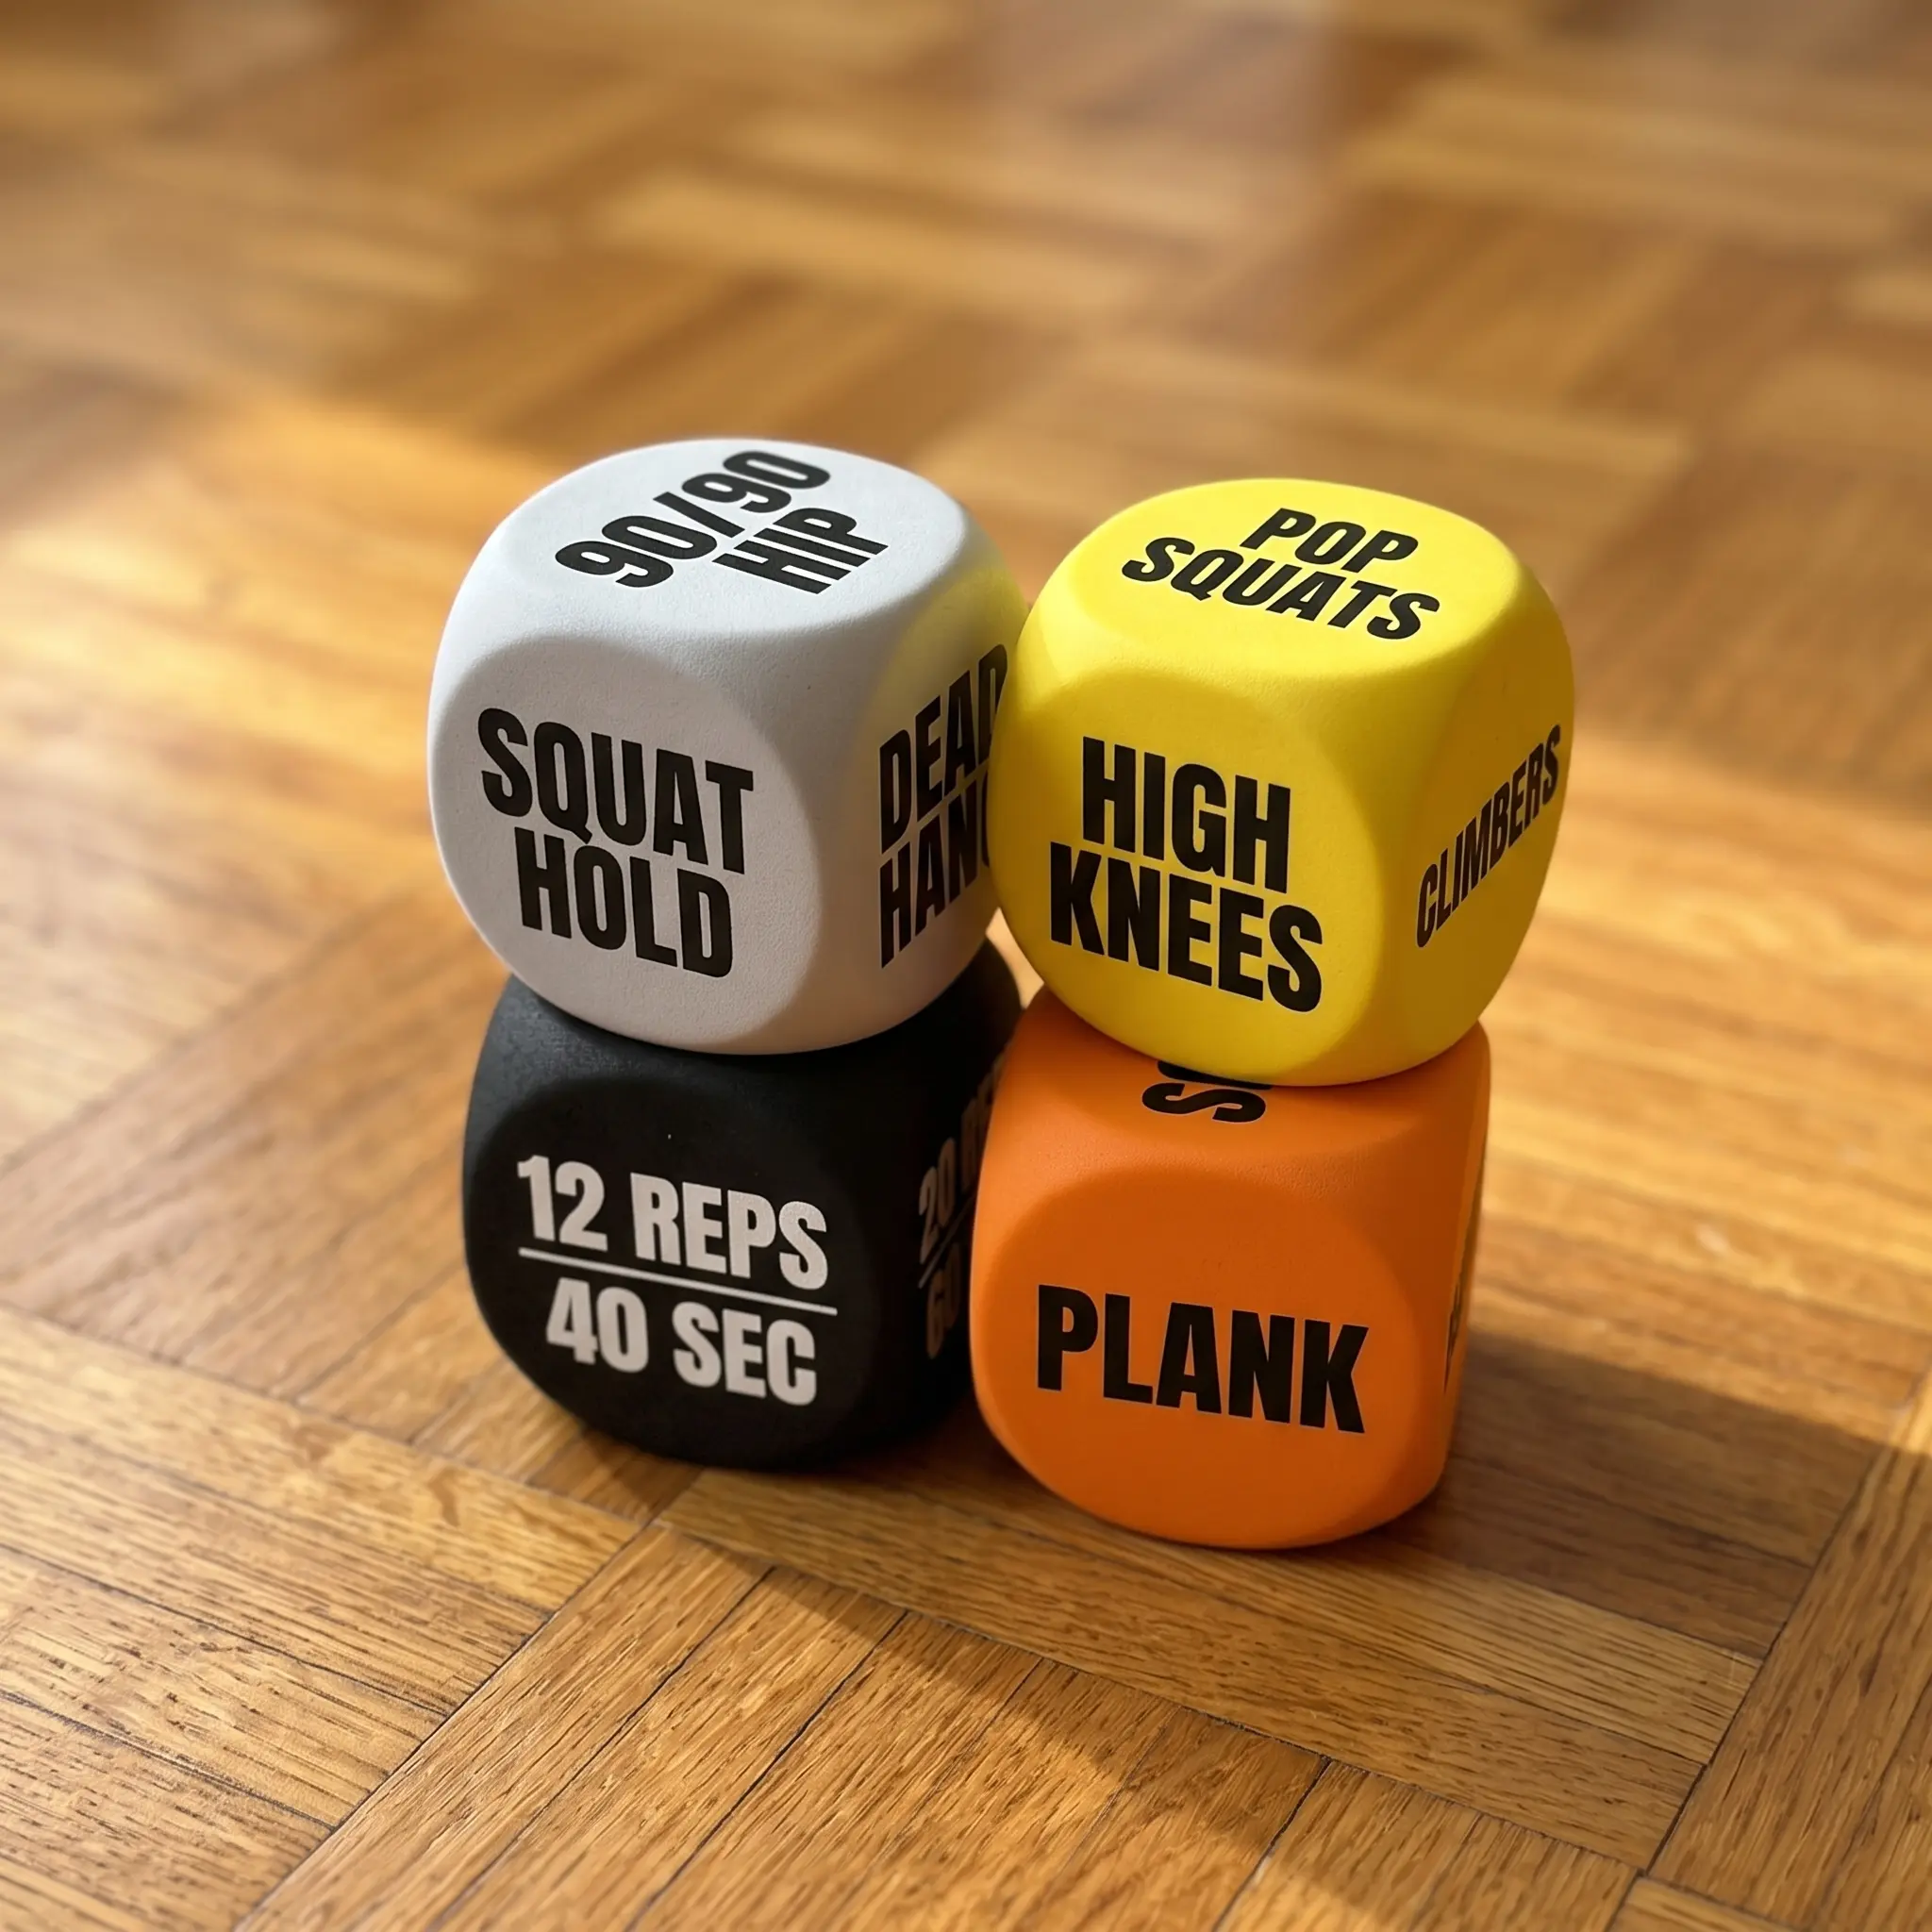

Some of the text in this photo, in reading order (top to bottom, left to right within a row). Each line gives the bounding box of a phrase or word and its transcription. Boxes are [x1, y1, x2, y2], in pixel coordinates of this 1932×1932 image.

[555, 451, 831, 589] 90/90
[711, 508, 889, 594] HIP
[1122, 537, 1441, 641] SQUATS
[1239, 508, 1419, 574] POP
[477, 708, 754, 875] SQUAT
[879, 643, 1008, 855] DEAD
[1082, 736, 1291, 894] HIGH
[513, 826, 733, 978] HOLD
[1416, 724, 1561, 948] CLIMBERS
[1050, 841, 1323, 1012] KNEES
[517, 1155, 828, 1291] 12 REPS
[918, 1137, 956, 1265] 20
[546, 1277, 817, 1407] 40 SEC
[1038, 1283, 1371, 1434] PLANK
